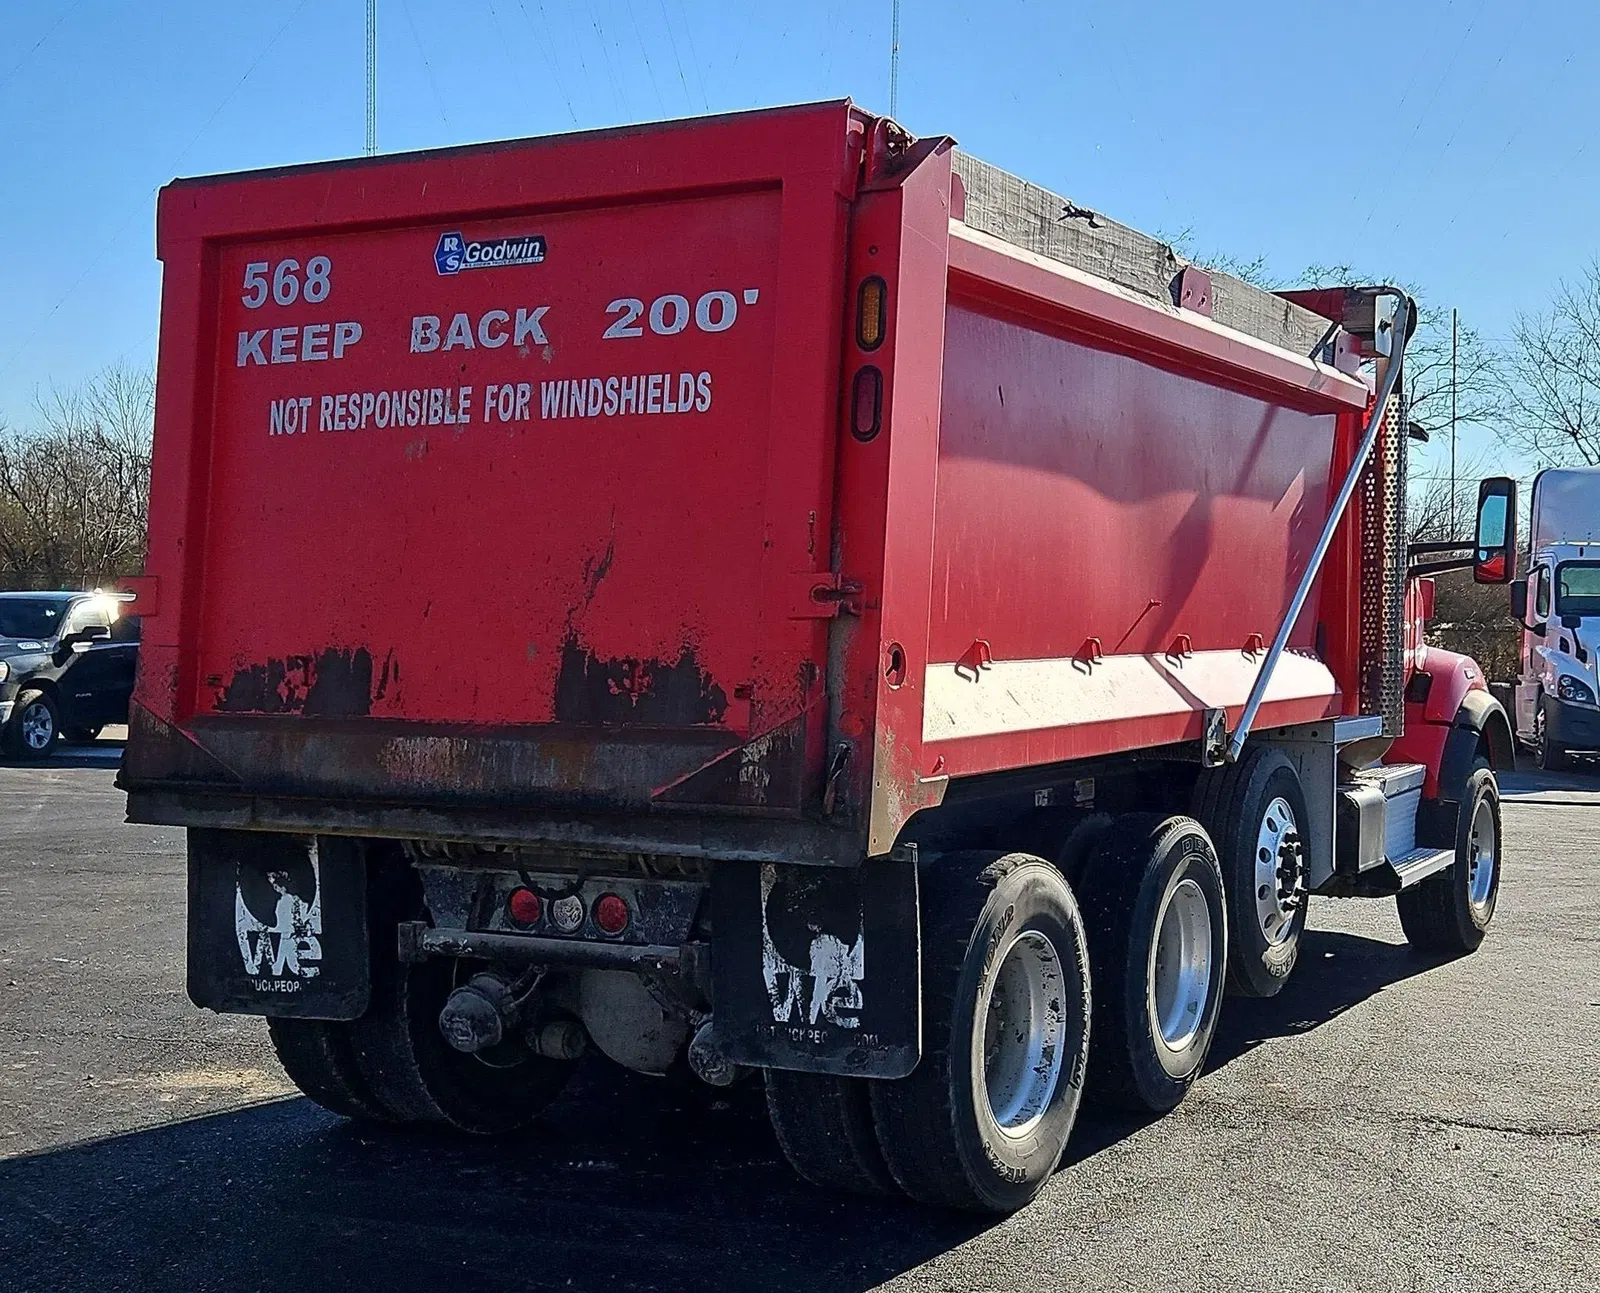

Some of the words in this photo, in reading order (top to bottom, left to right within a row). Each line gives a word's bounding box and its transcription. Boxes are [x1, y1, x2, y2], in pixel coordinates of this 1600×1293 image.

[465, 238, 540, 263] Godwin
[240, 256, 332, 309] 568
[237, 322, 363, 367] KEEP
[409, 306, 552, 354] BACK
[602, 288, 760, 339] 200'
[269, 397, 313, 436] NOT
[319, 386, 473, 432] RESPONSIBLE
[484, 383, 532, 423] FOR
[541, 371, 712, 420] WINDSHIELDS
